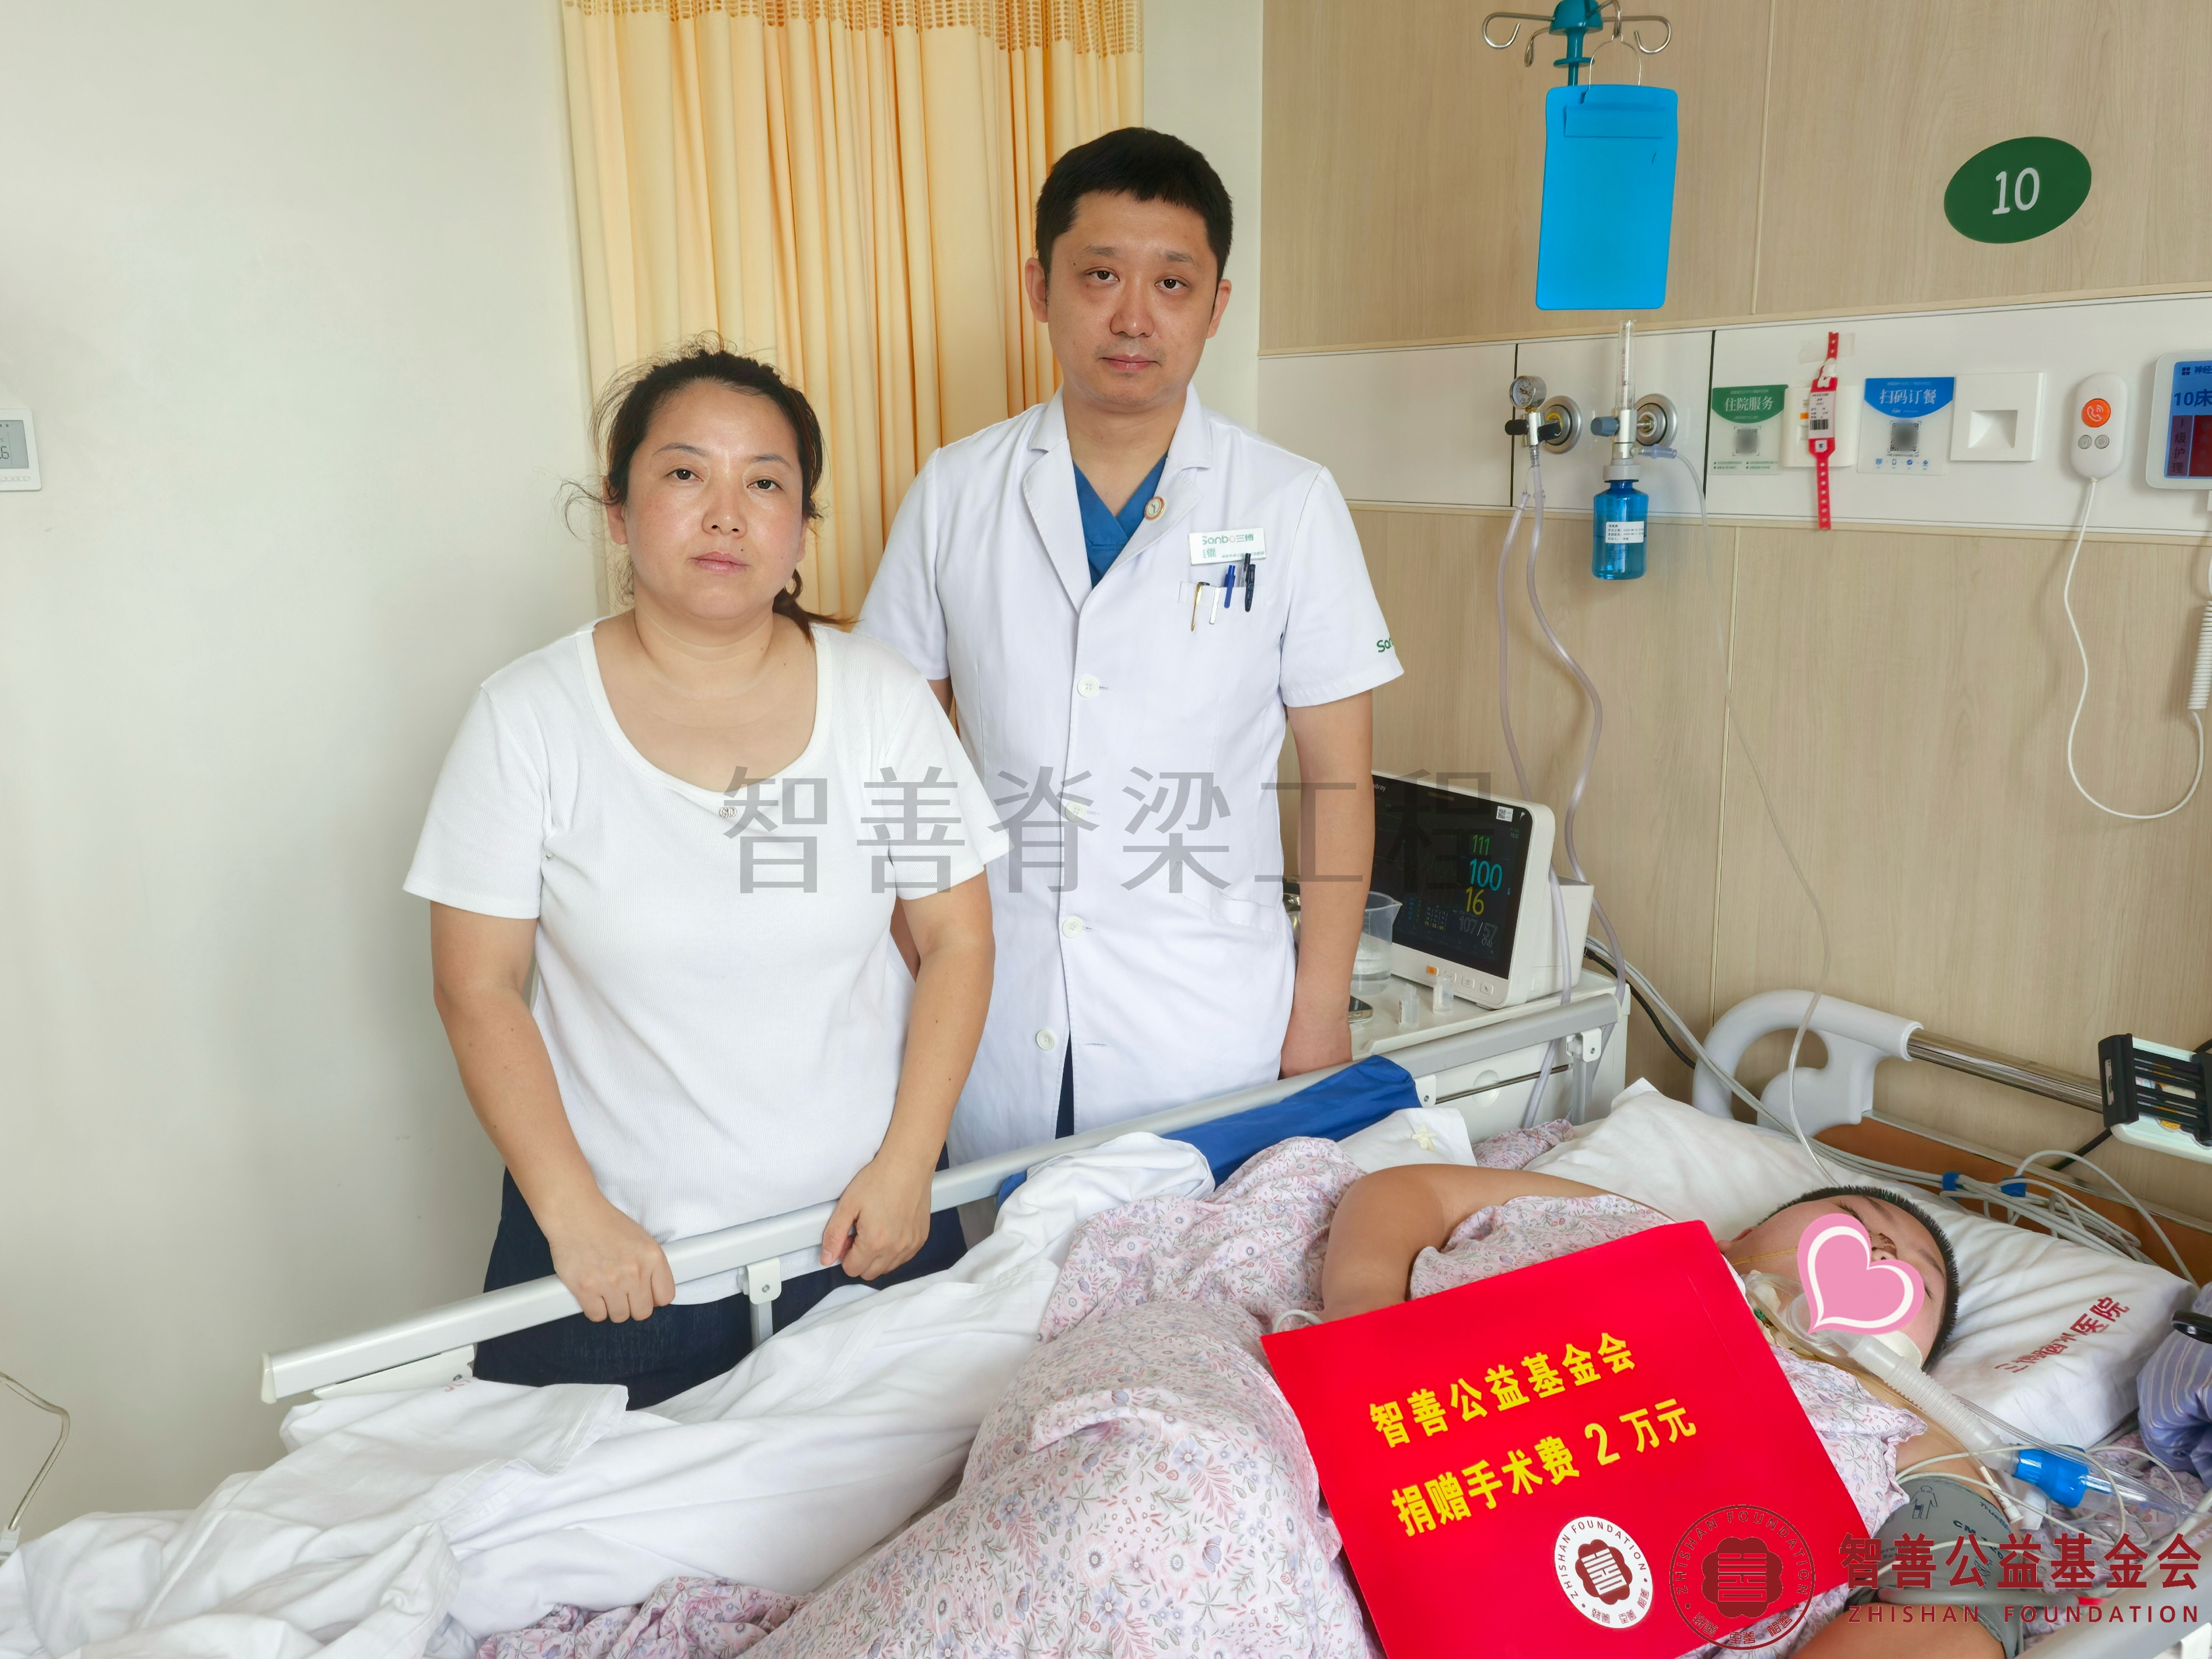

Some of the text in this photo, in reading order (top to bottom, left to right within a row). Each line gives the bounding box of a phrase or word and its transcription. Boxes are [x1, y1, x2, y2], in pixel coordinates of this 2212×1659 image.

[1992, 167, 2040, 215] 10
[1725, 396, 1773, 412] 住院服务
[1879, 389, 1937, 405] 扫码订餐
[1473, 834, 1490, 855] 111
[1471, 858, 1503, 891] 100
[1466, 886, 1485, 915] 16
[1370, 1333, 1634, 1448] 智善公益基金会
[1392, 1399, 1696, 1536] 捐赠手术费 2 万元
[1558, 1520, 1646, 1599] ZHISHAN FOUNDATION
